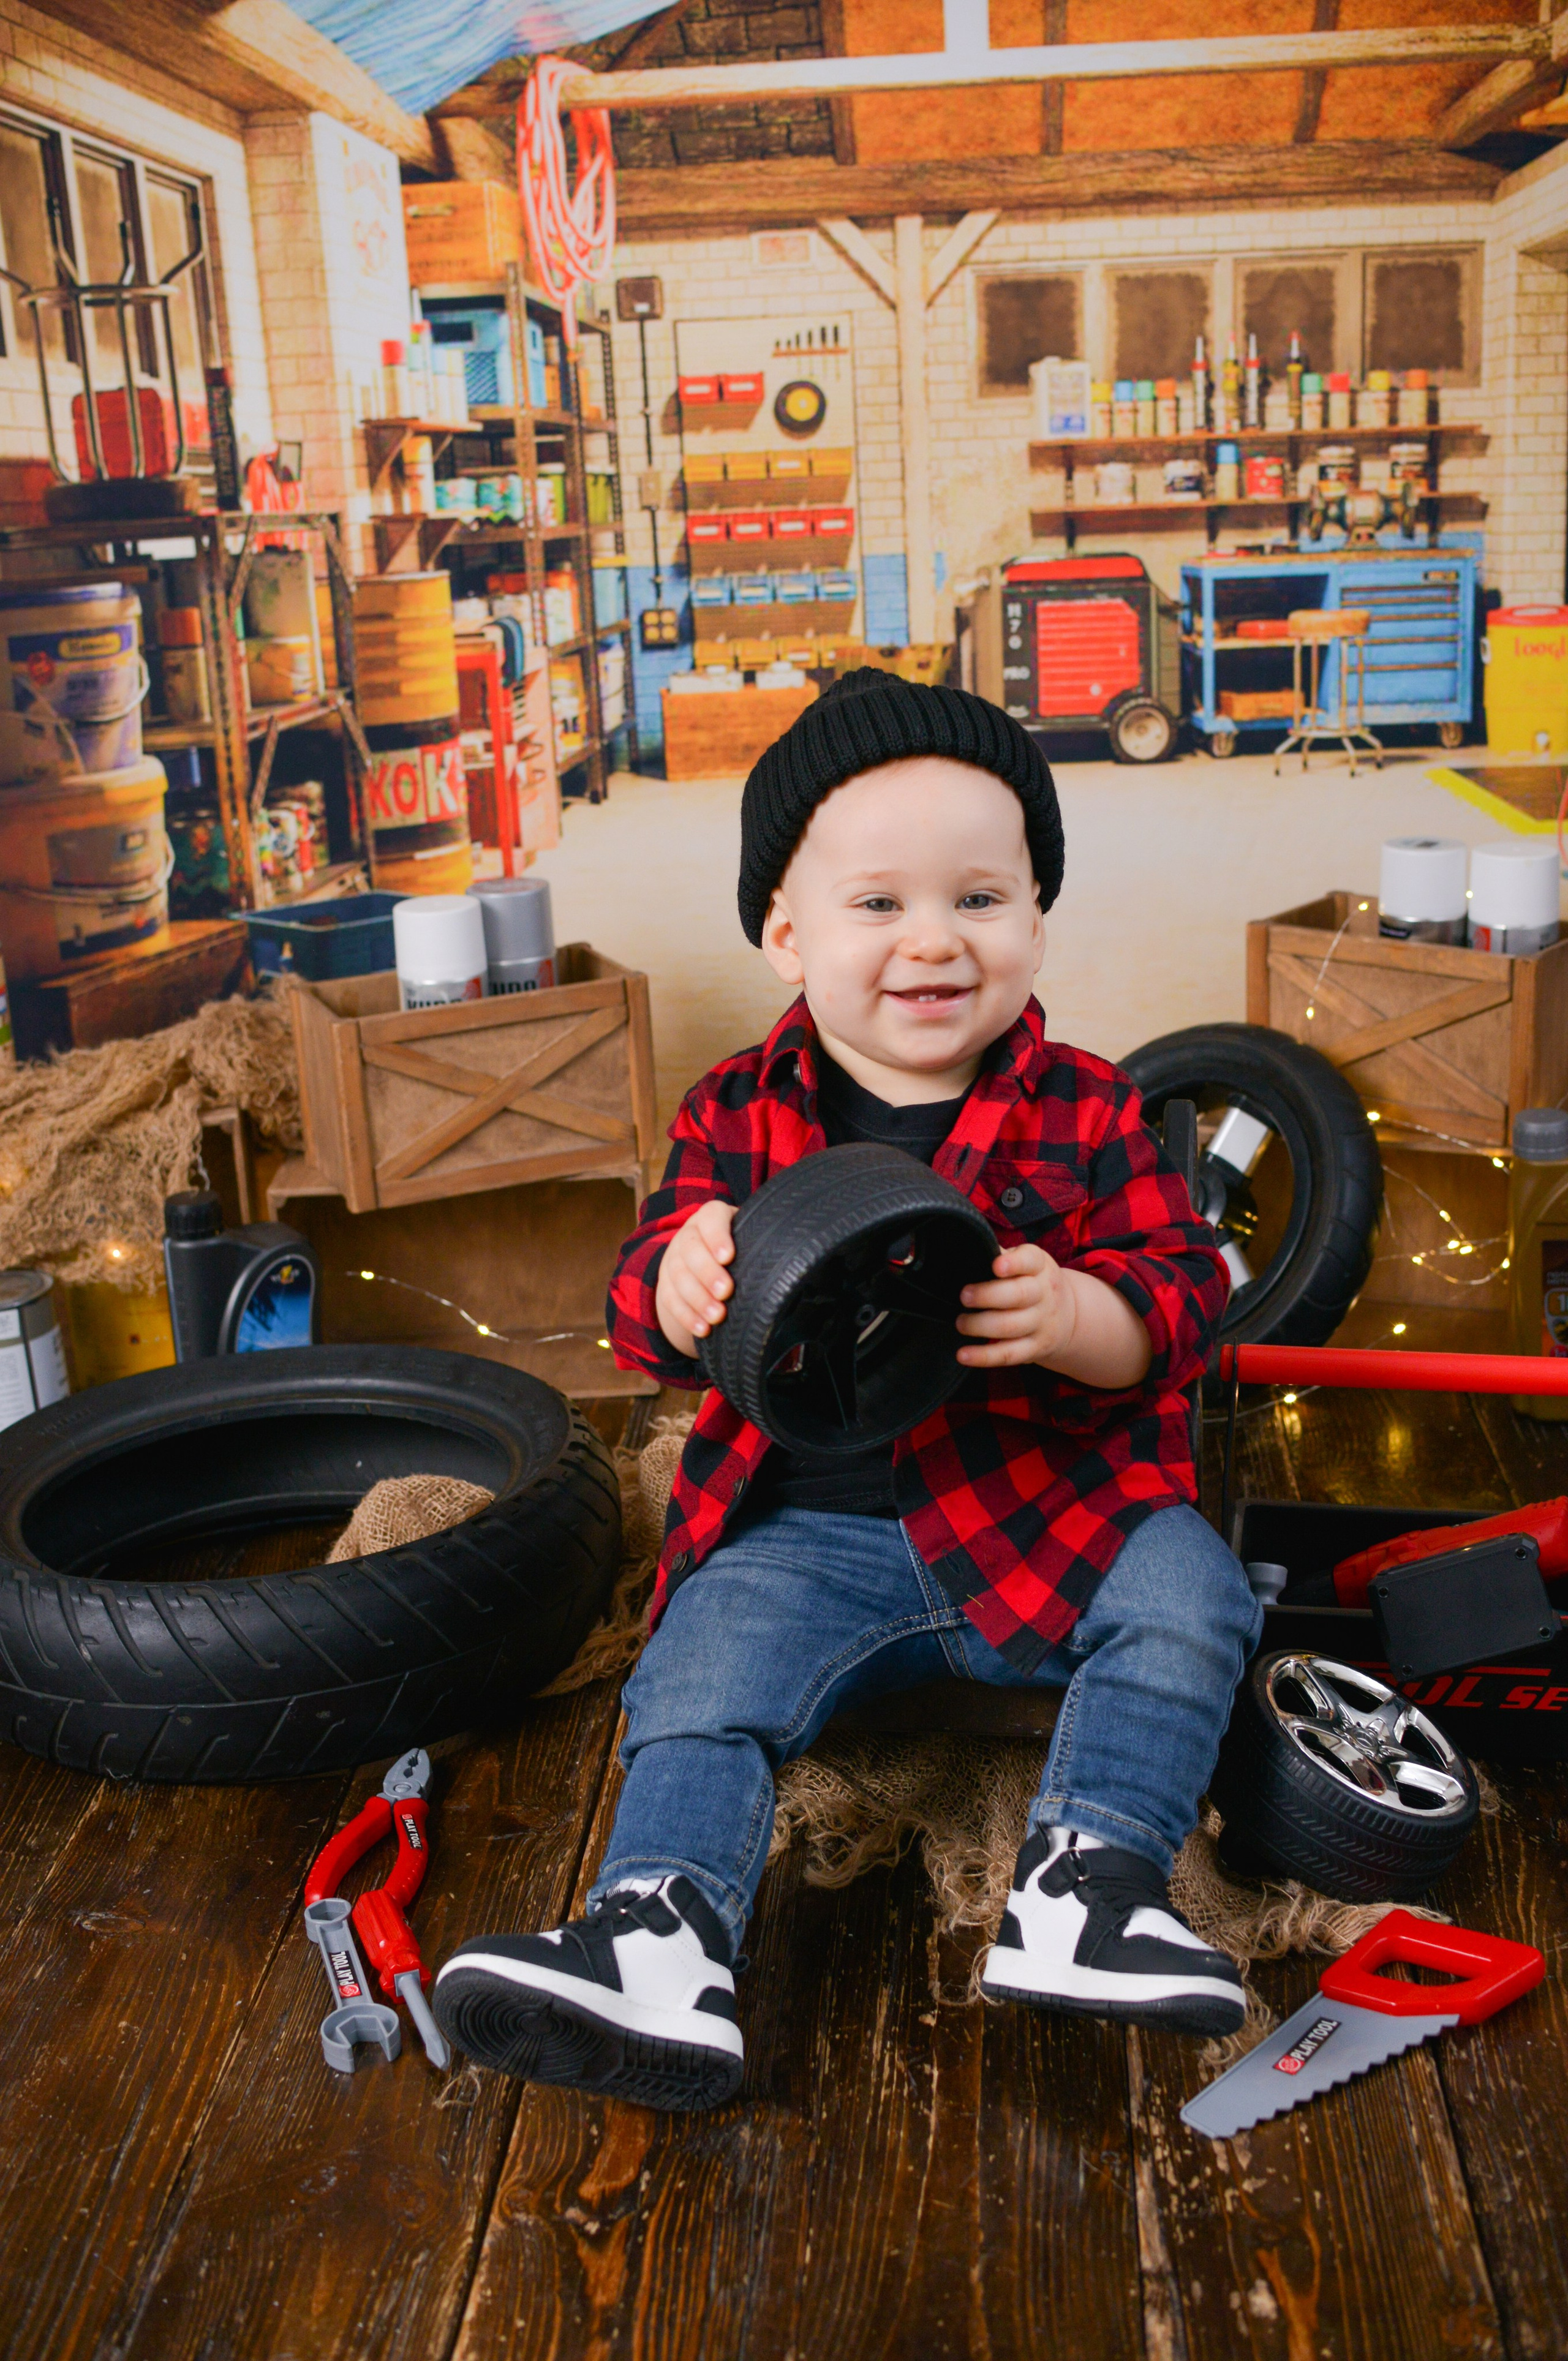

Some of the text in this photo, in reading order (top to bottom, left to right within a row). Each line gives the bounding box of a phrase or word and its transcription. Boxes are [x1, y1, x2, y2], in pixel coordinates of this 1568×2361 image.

[405, 1818, 422, 1848] PLAY TOOL
[331, 1951, 349, 1970] TOOL
[336, 1968, 355, 1986] PLAY
[1290, 2038, 1318, 2060] PLAY
[1308, 2020, 1338, 2040] TOOL
